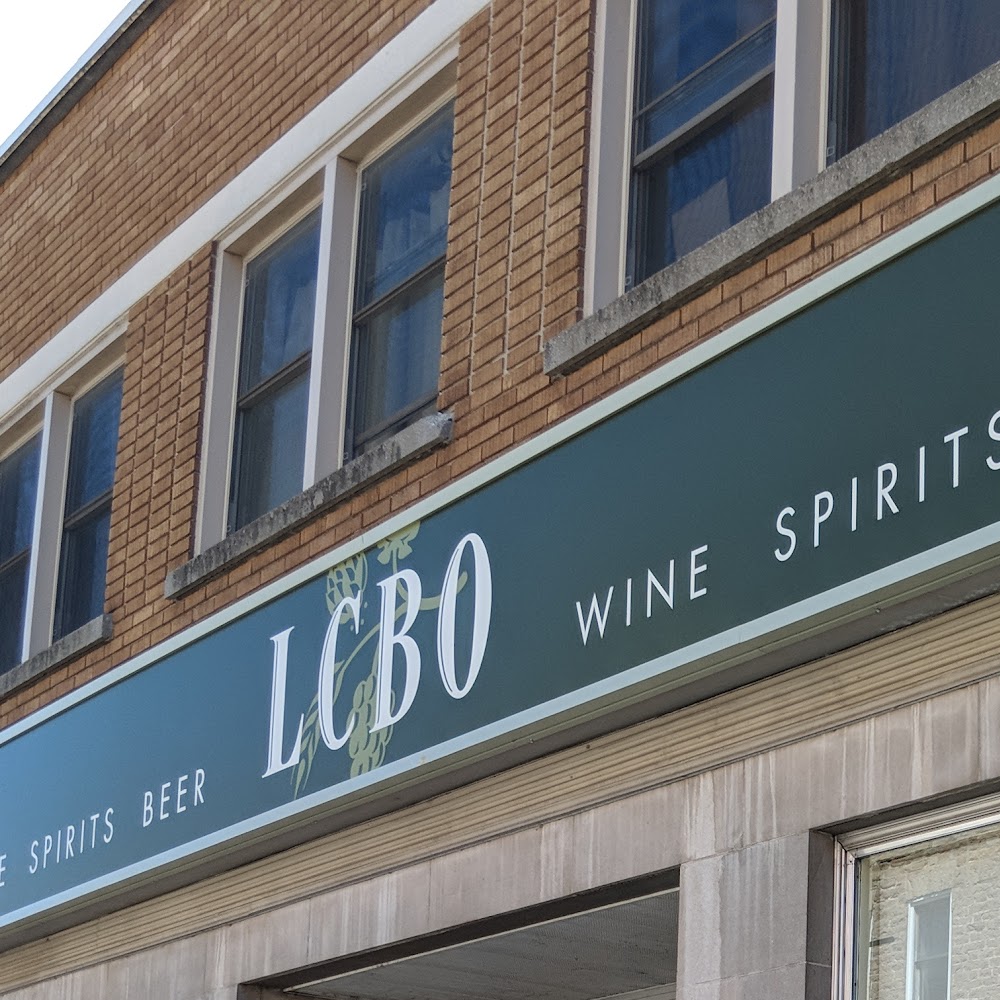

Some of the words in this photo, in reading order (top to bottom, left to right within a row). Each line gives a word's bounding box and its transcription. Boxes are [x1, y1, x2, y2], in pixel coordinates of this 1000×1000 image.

[575, 544, 709, 647] WINE
[261, 532, 493, 779] LCBO
[29, 807, 114, 875] SPIRITS
[142, 768, 206, 828] BEER
